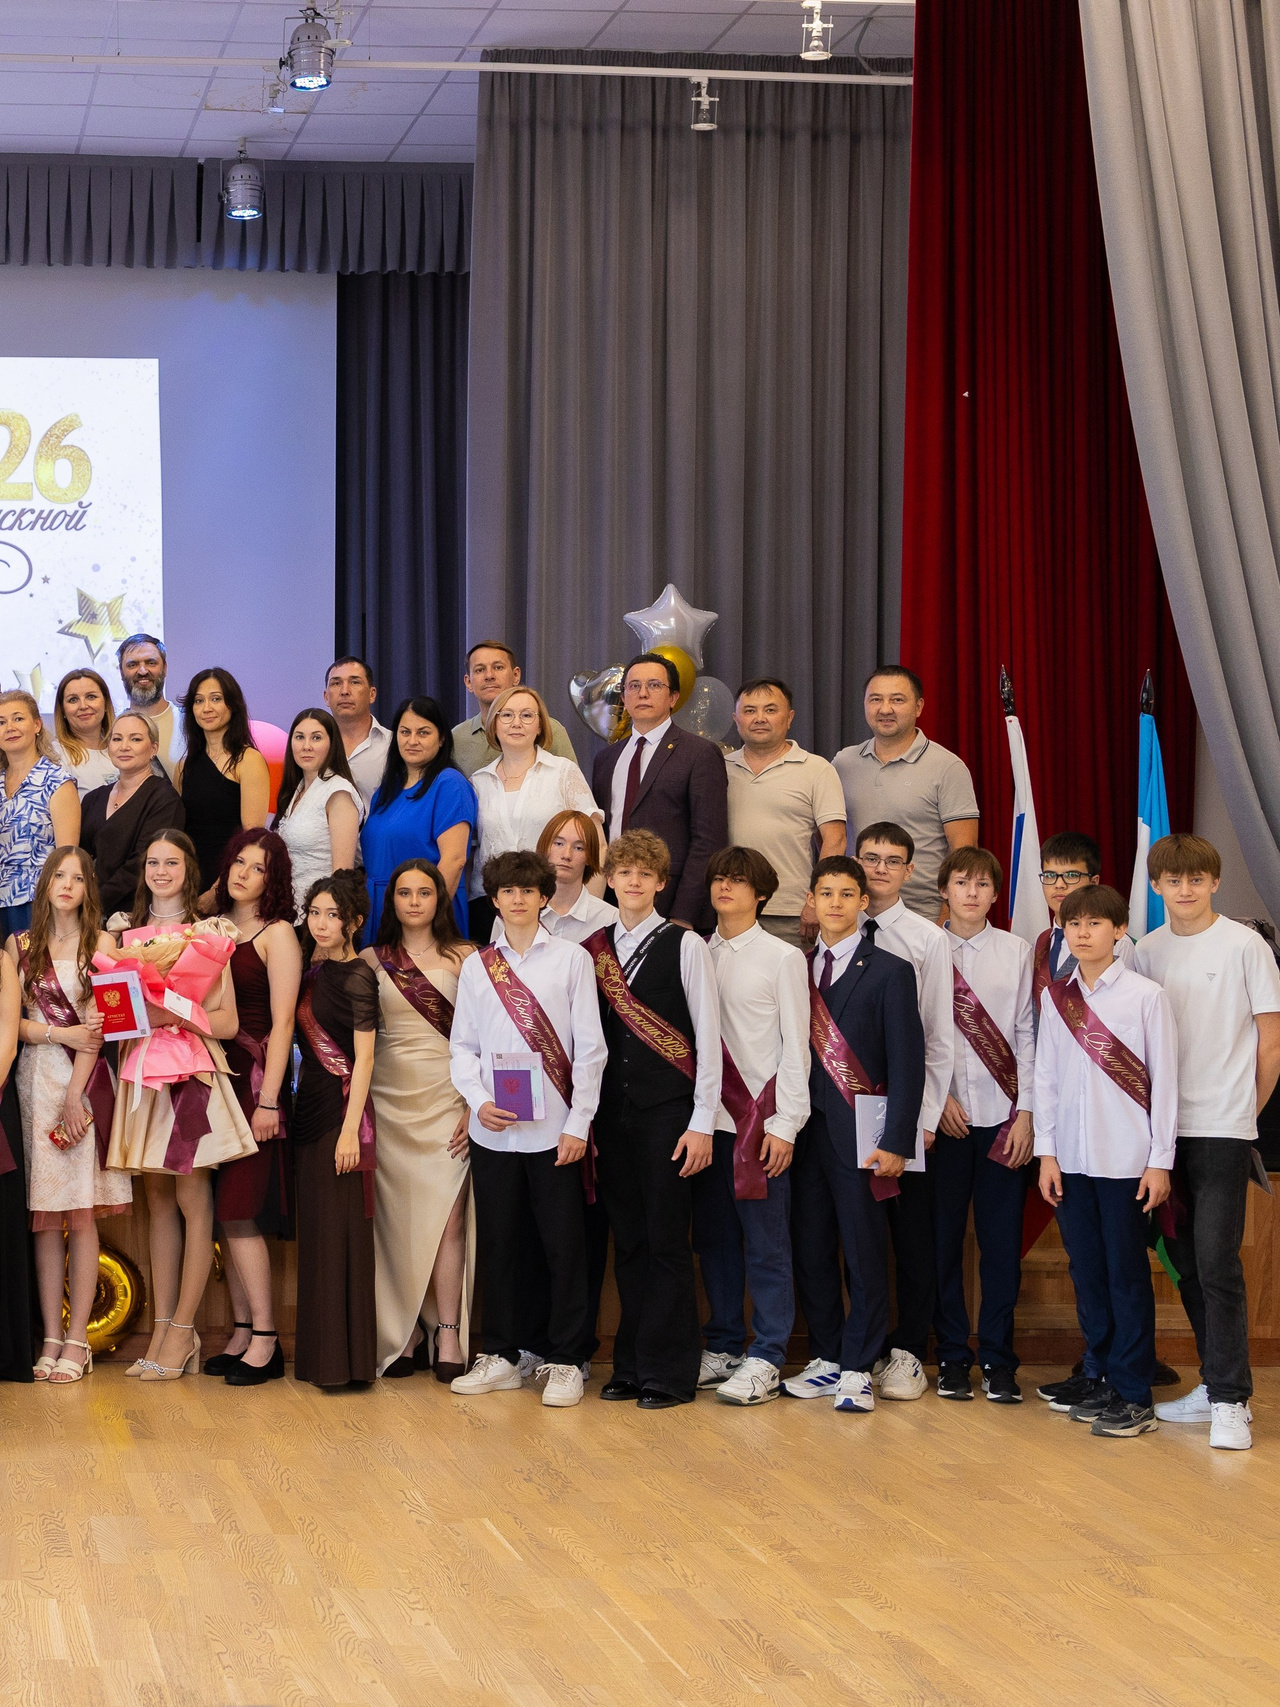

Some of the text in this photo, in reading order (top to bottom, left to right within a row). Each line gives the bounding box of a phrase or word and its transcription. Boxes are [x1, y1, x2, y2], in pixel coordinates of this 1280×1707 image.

[504, 988, 558, 1066] Выпускник
[602, 975, 663, 1040] Выпускник
[657, 1034, 691, 1059] 2026
[953, 994, 1007, 1069] Выпускник
[1001, 1073, 1017, 1095] 202
[830, 1060, 871, 1093] 2026
[1082, 1032, 1147, 1098] Выпускни
